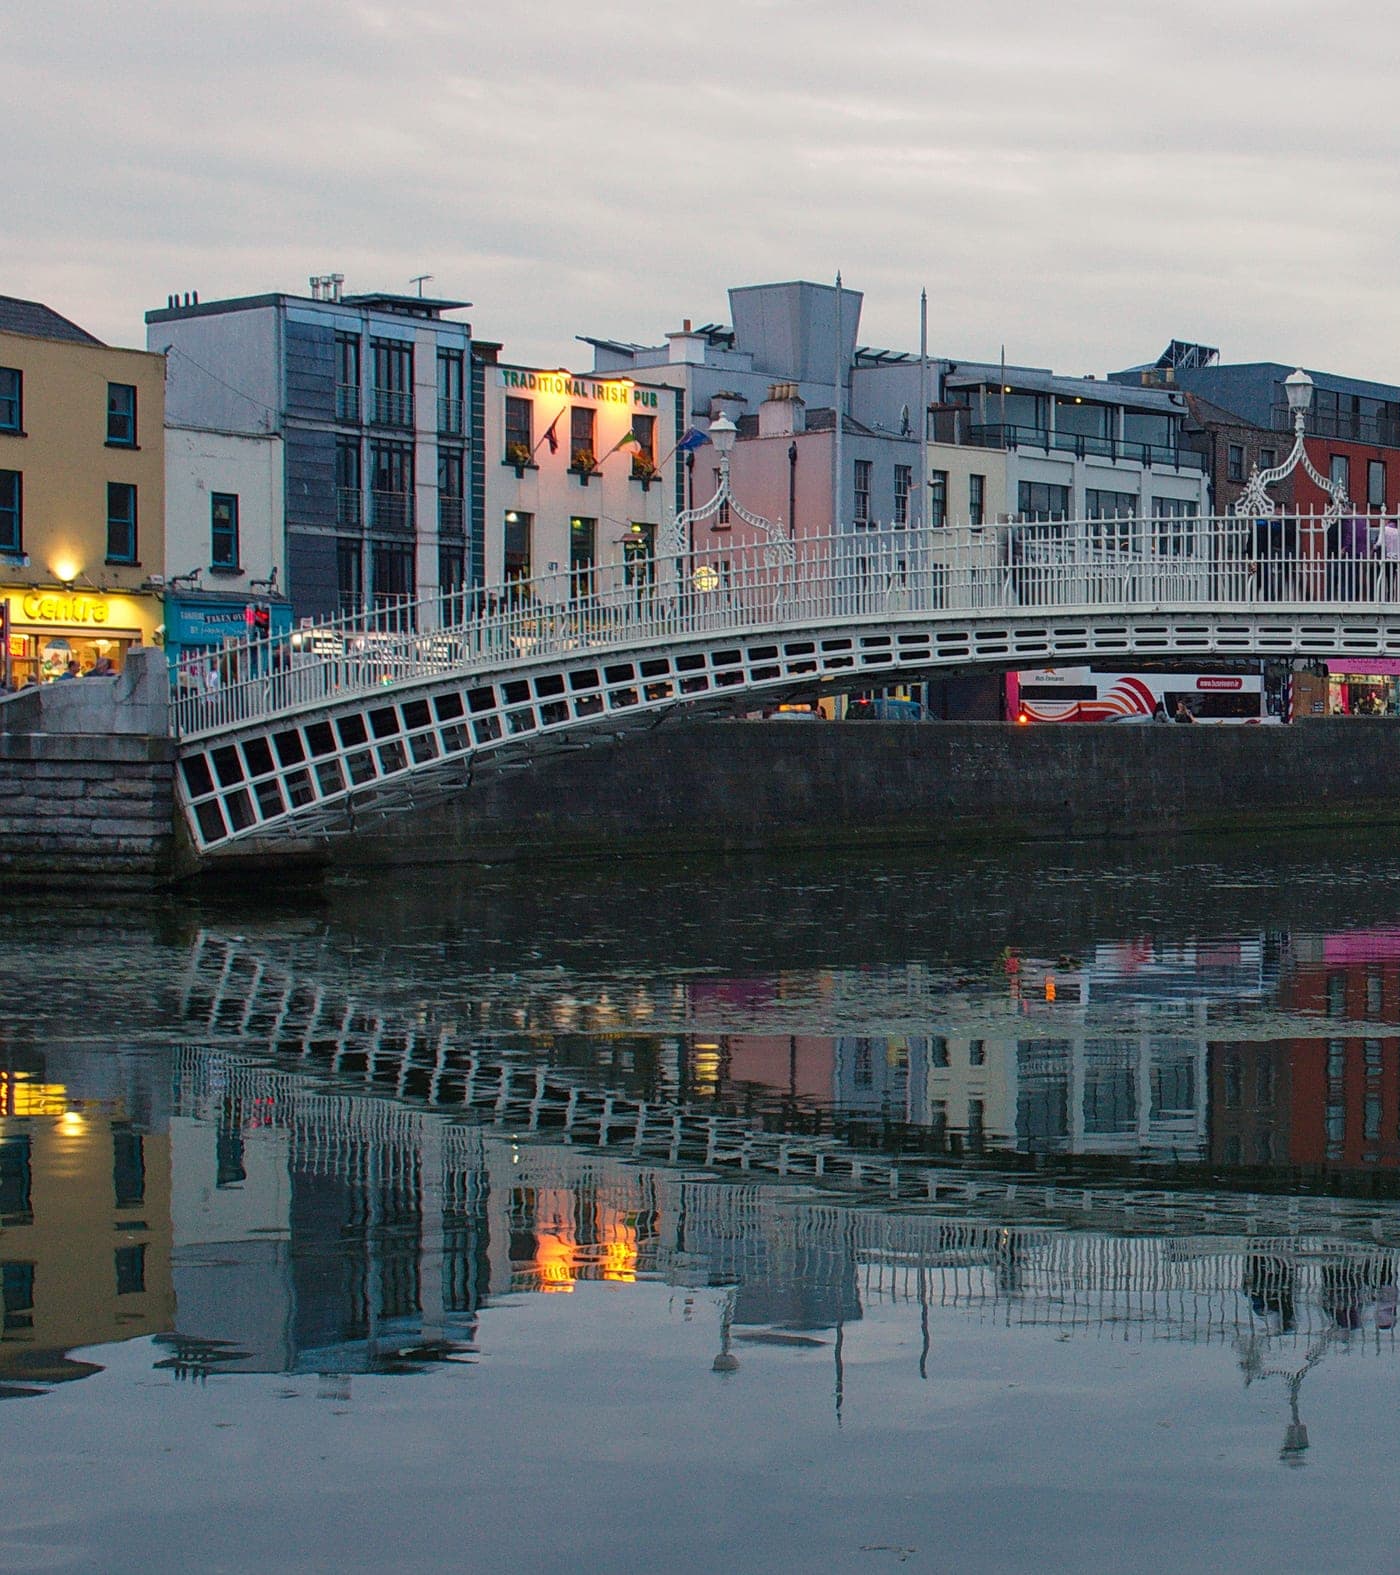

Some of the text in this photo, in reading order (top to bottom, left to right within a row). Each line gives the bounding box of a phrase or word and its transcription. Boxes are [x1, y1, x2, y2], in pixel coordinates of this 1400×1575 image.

[502, 370, 658, 408] TRADITIONAL IRISH PUB
[22, 592, 110, 623] Centra
